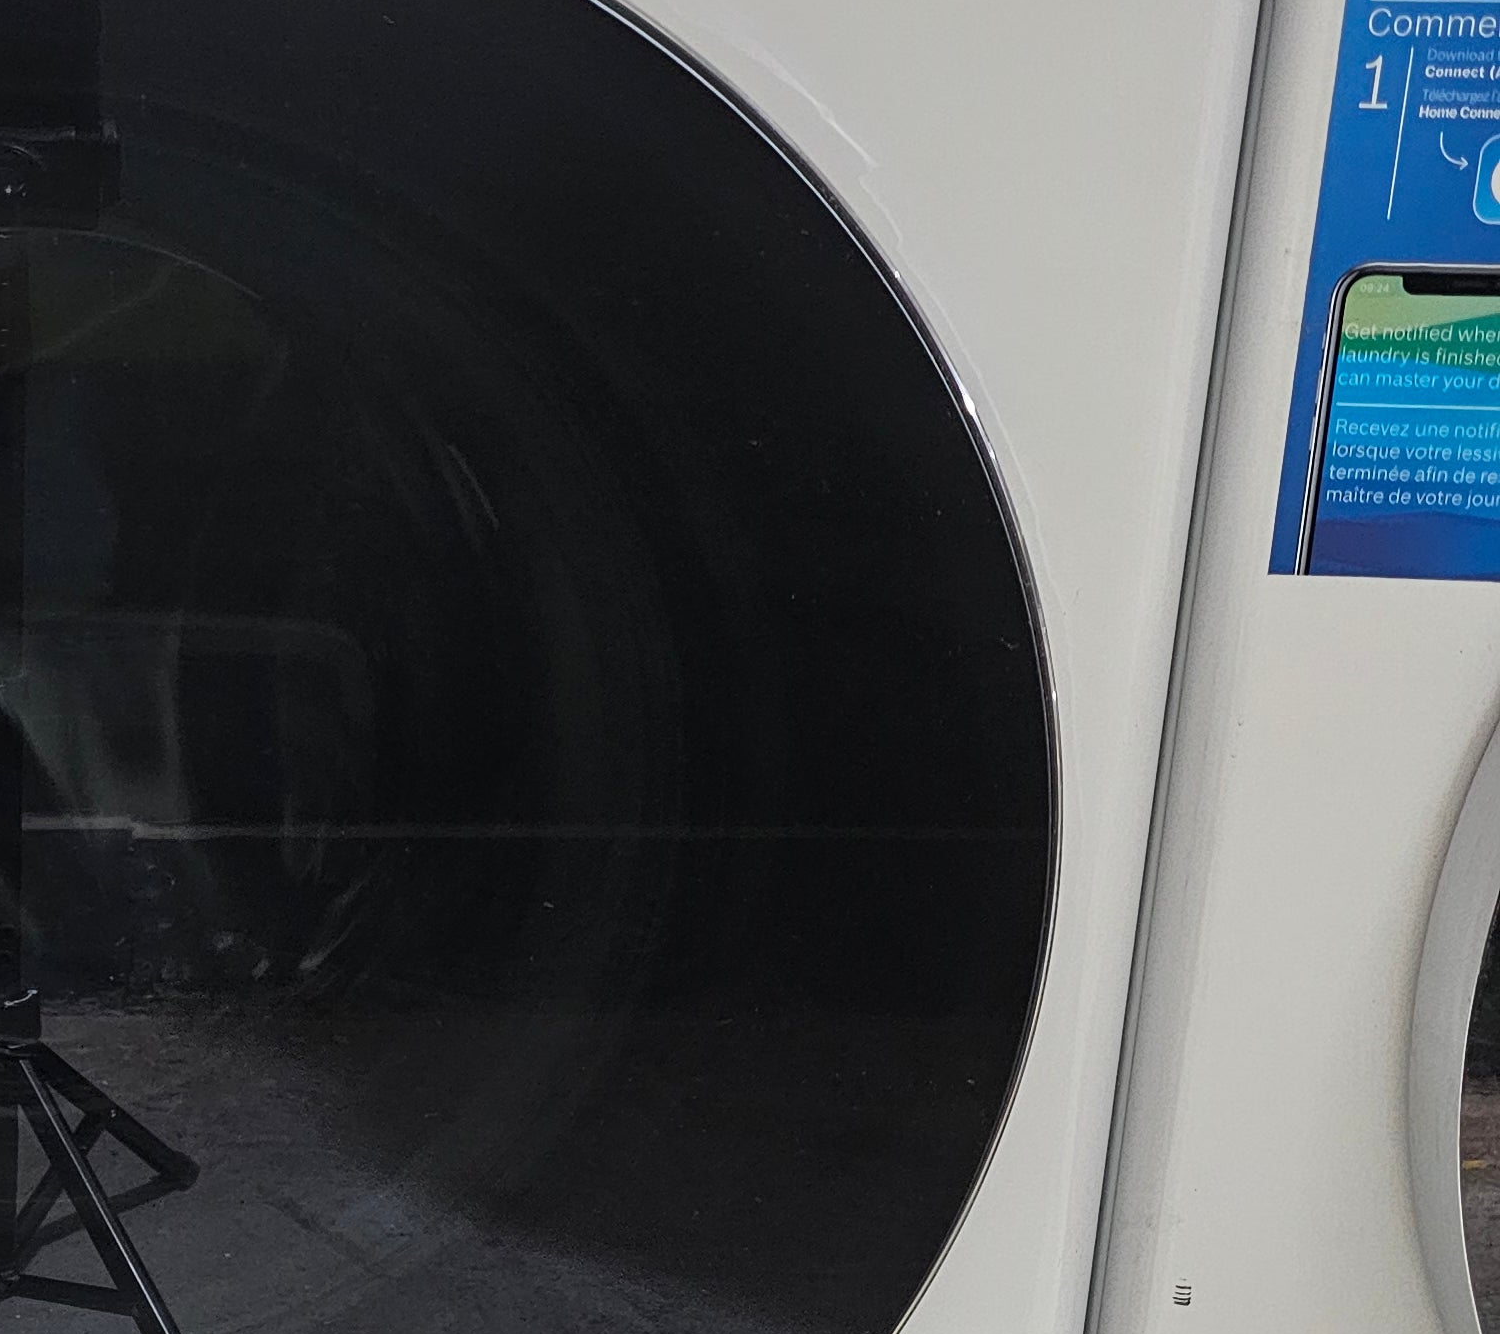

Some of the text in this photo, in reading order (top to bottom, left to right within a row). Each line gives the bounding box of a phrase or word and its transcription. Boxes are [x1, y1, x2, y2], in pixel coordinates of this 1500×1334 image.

[1367, 7, 1500, 39] Comme
[1427, 47, 1495, 62] Download
[1358, 54, 1389, 109] 1
[1425, 64, 1485, 79] Connect
[1418, 104, 1458, 119] Home
[1343, 323, 1377, 341] Get
[1381, 324, 1454, 342] notified
[1340, 344, 1411, 367] laundry
[1414, 347, 1430, 365] is
[1337, 372, 1371, 387] can
[1375, 371, 1441, 389] master
[1442, 375, 1487, 393] your
[1334, 418, 1411, 438] Recevez
[1414, 423, 1450, 438] une
[1332, 439, 1500, 463] lorsque votre lessi
[1328, 463, 1500, 486] terminée afin de re
[1325, 485, 1385, 504] maître
[1388, 486, 1412, 505] de
[1415, 489, 1463, 507] votre
